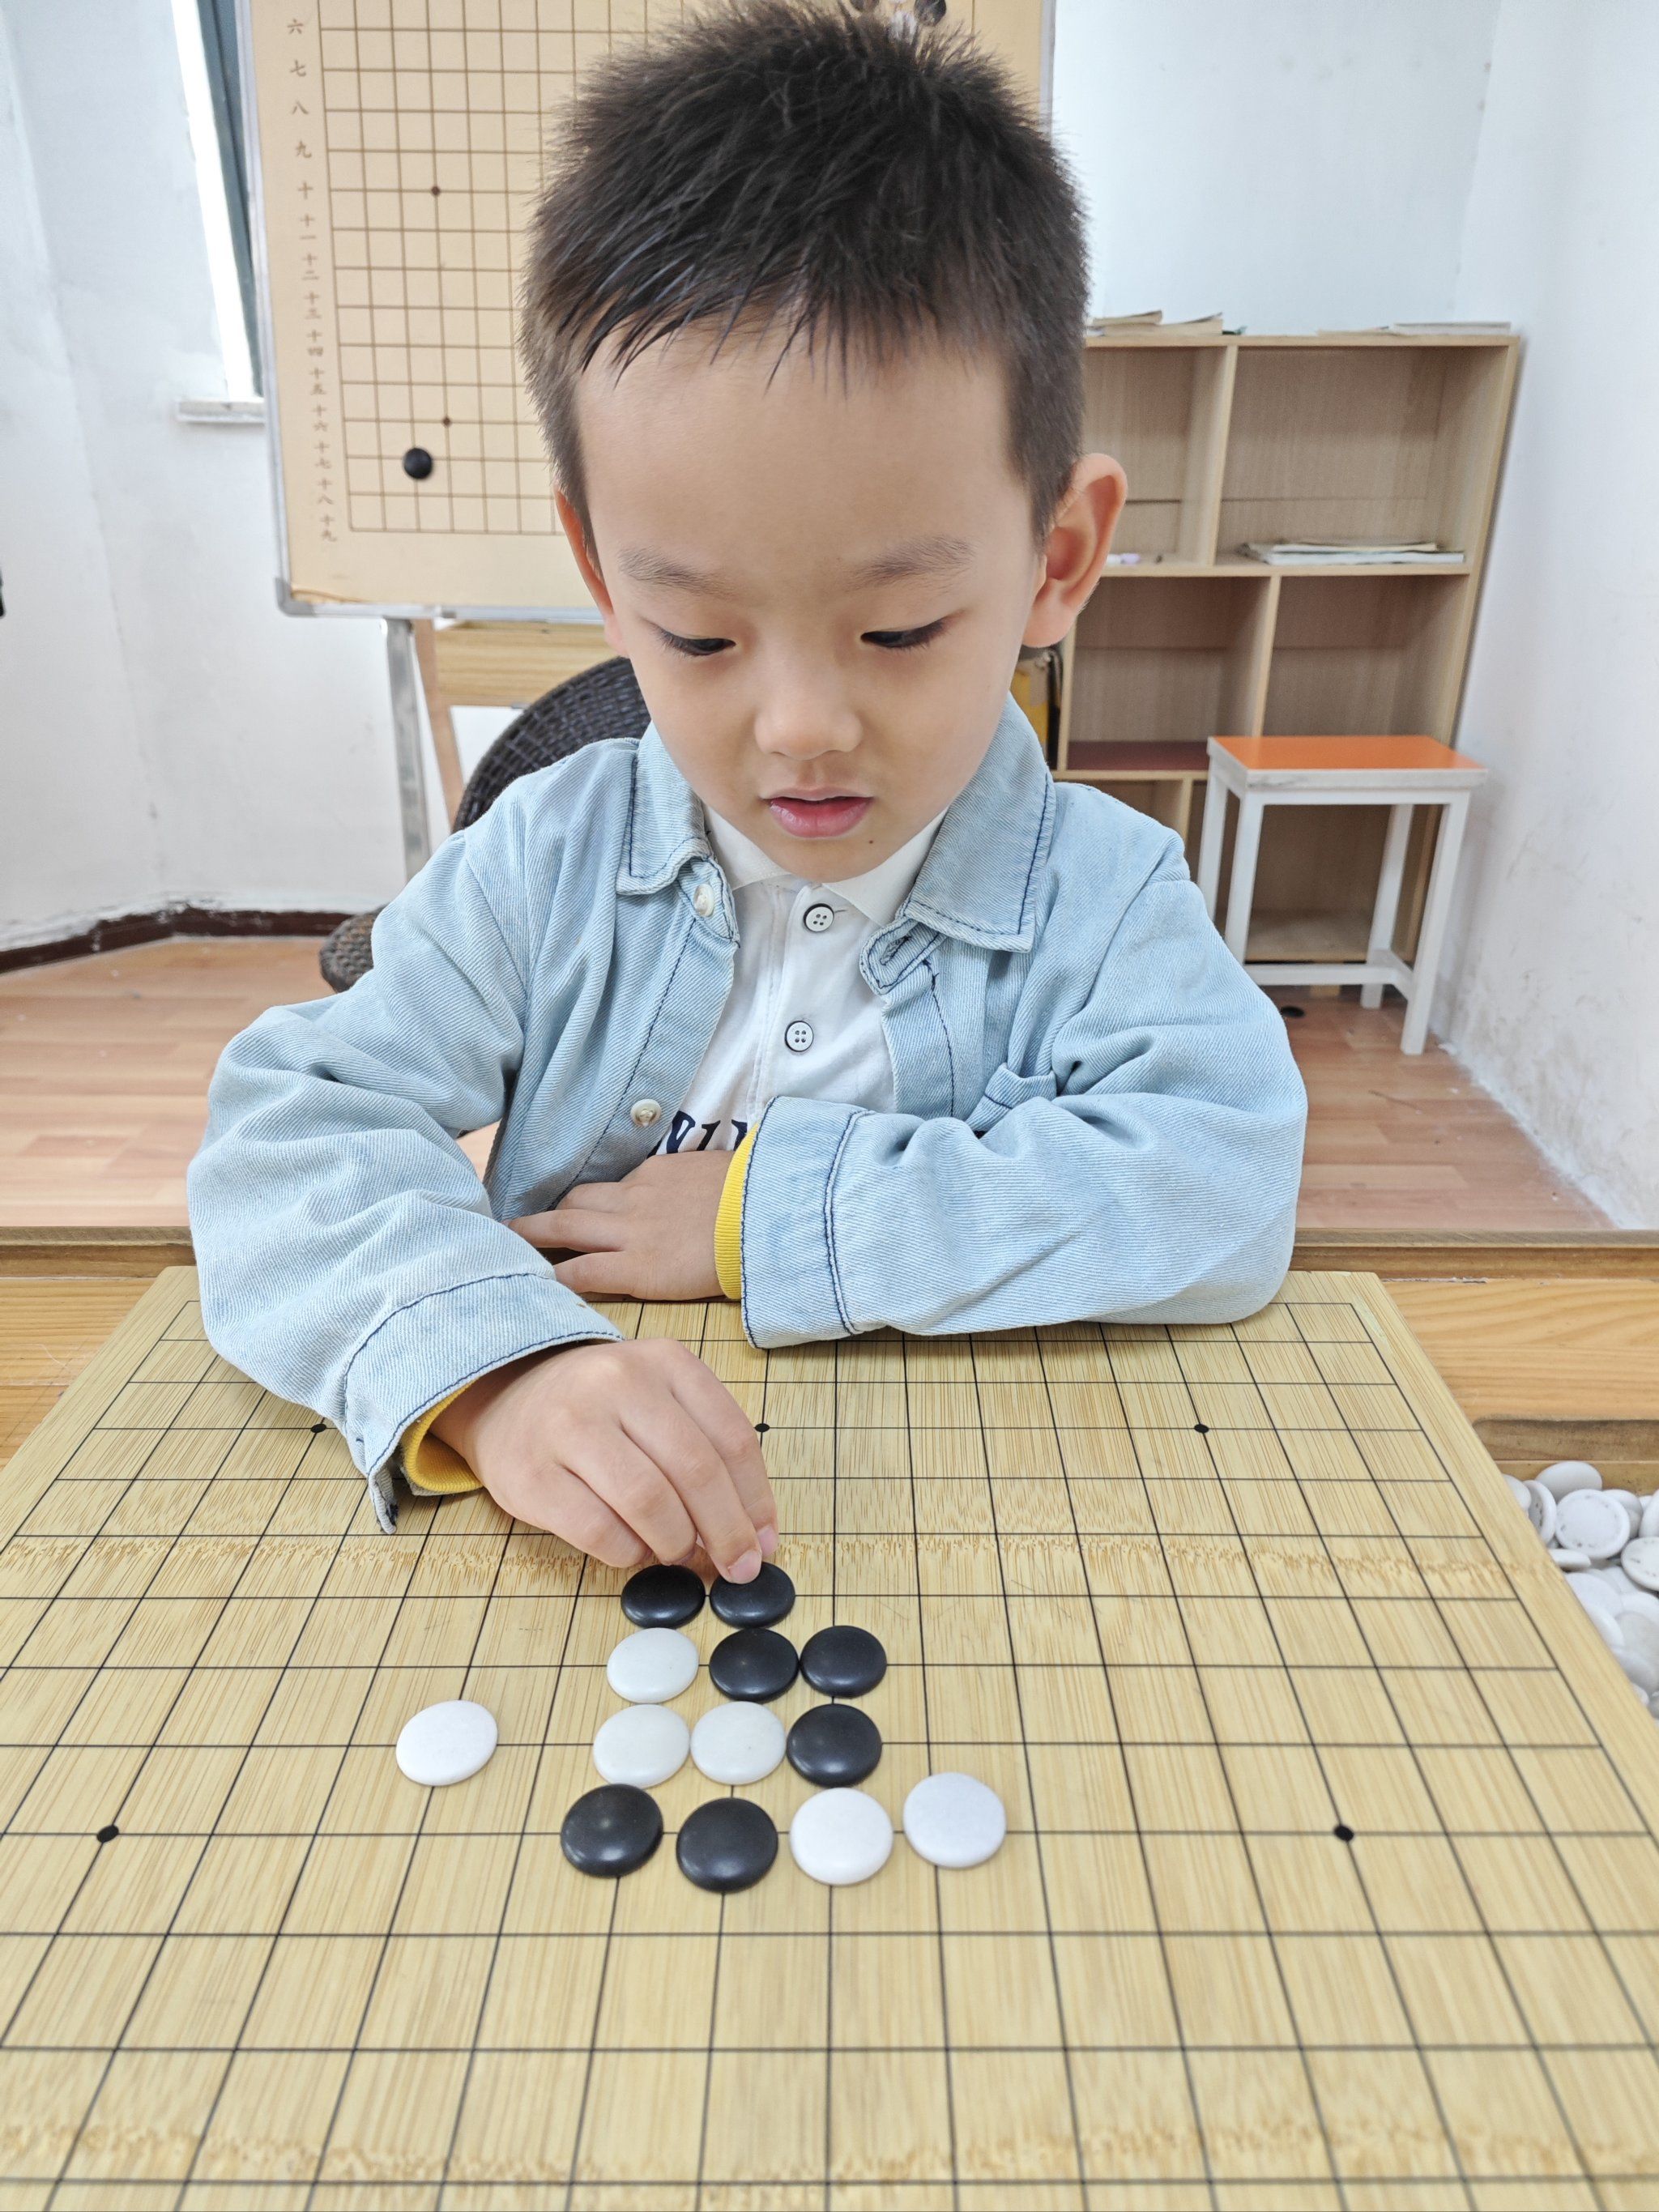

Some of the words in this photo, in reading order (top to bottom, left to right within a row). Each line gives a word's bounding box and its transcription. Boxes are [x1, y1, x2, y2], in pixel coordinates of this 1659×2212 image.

[286, 18, 305, 35] 六
[288, 59, 307, 78] 七
[291, 100, 309, 116] 八
[295, 139, 313, 159] 九
[297, 181, 314, 200] 十
[300, 214, 317, 241] 十一
[302, 253, 320, 281] 十二
[304, 292, 322, 320] 十三
[306, 329, 324, 357] 十四
[309, 367, 326, 396] 十五
[313, 404, 328, 433] 十六
[314, 441, 331, 470] 十七
[318, 477, 334, 505] 十八
[321, 514, 338, 543] 十九
